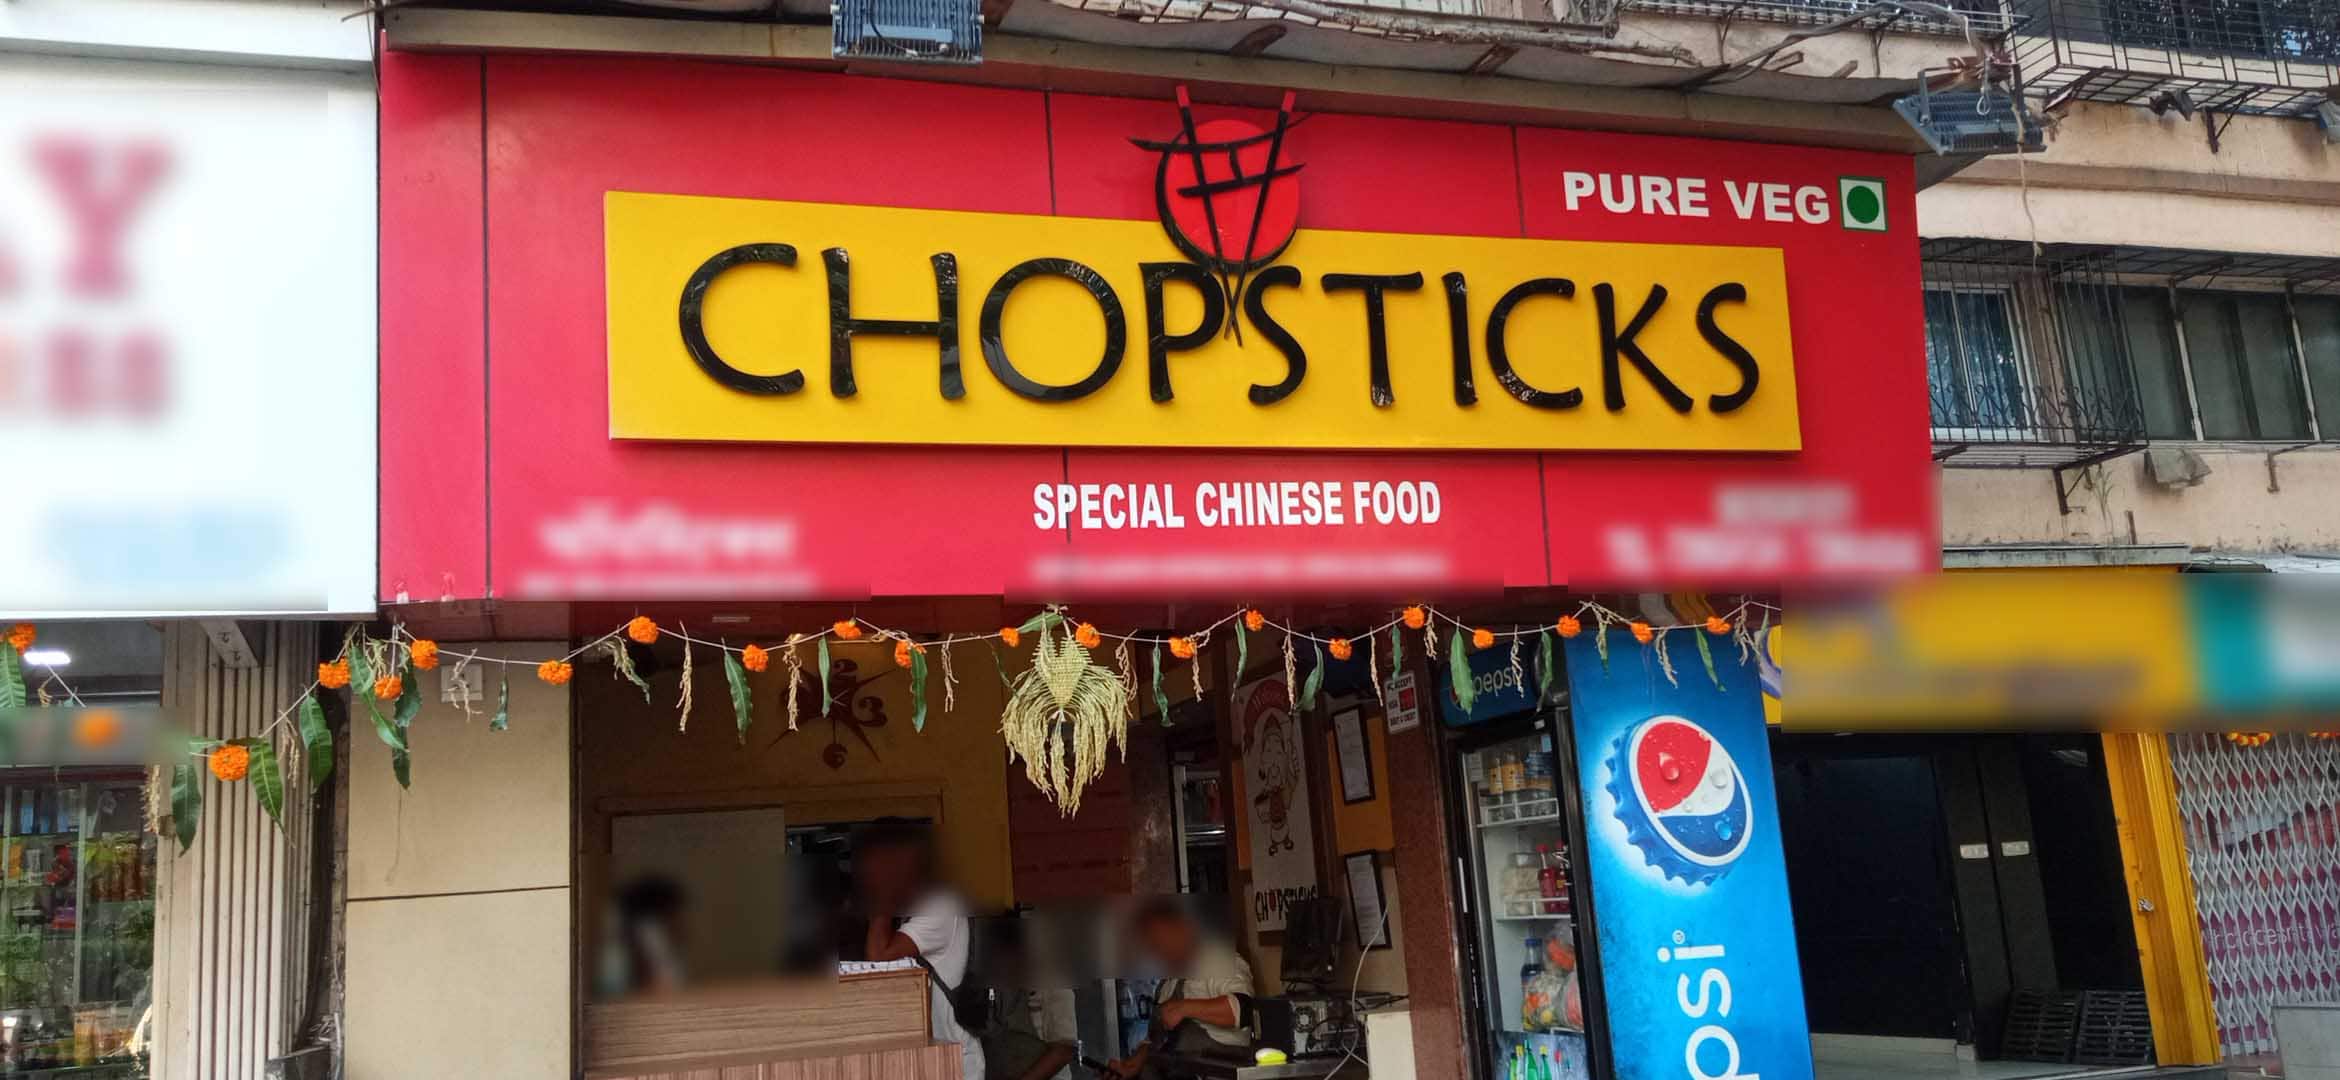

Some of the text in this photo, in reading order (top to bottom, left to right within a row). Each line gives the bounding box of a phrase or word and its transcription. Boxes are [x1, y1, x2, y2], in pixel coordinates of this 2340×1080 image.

[1563, 172, 1830, 225] PURE VEG
[678, 242, 1760, 415] CHOPSTICKS
[1033, 480, 1441, 530] SPECIAL CHINESE FOOD
